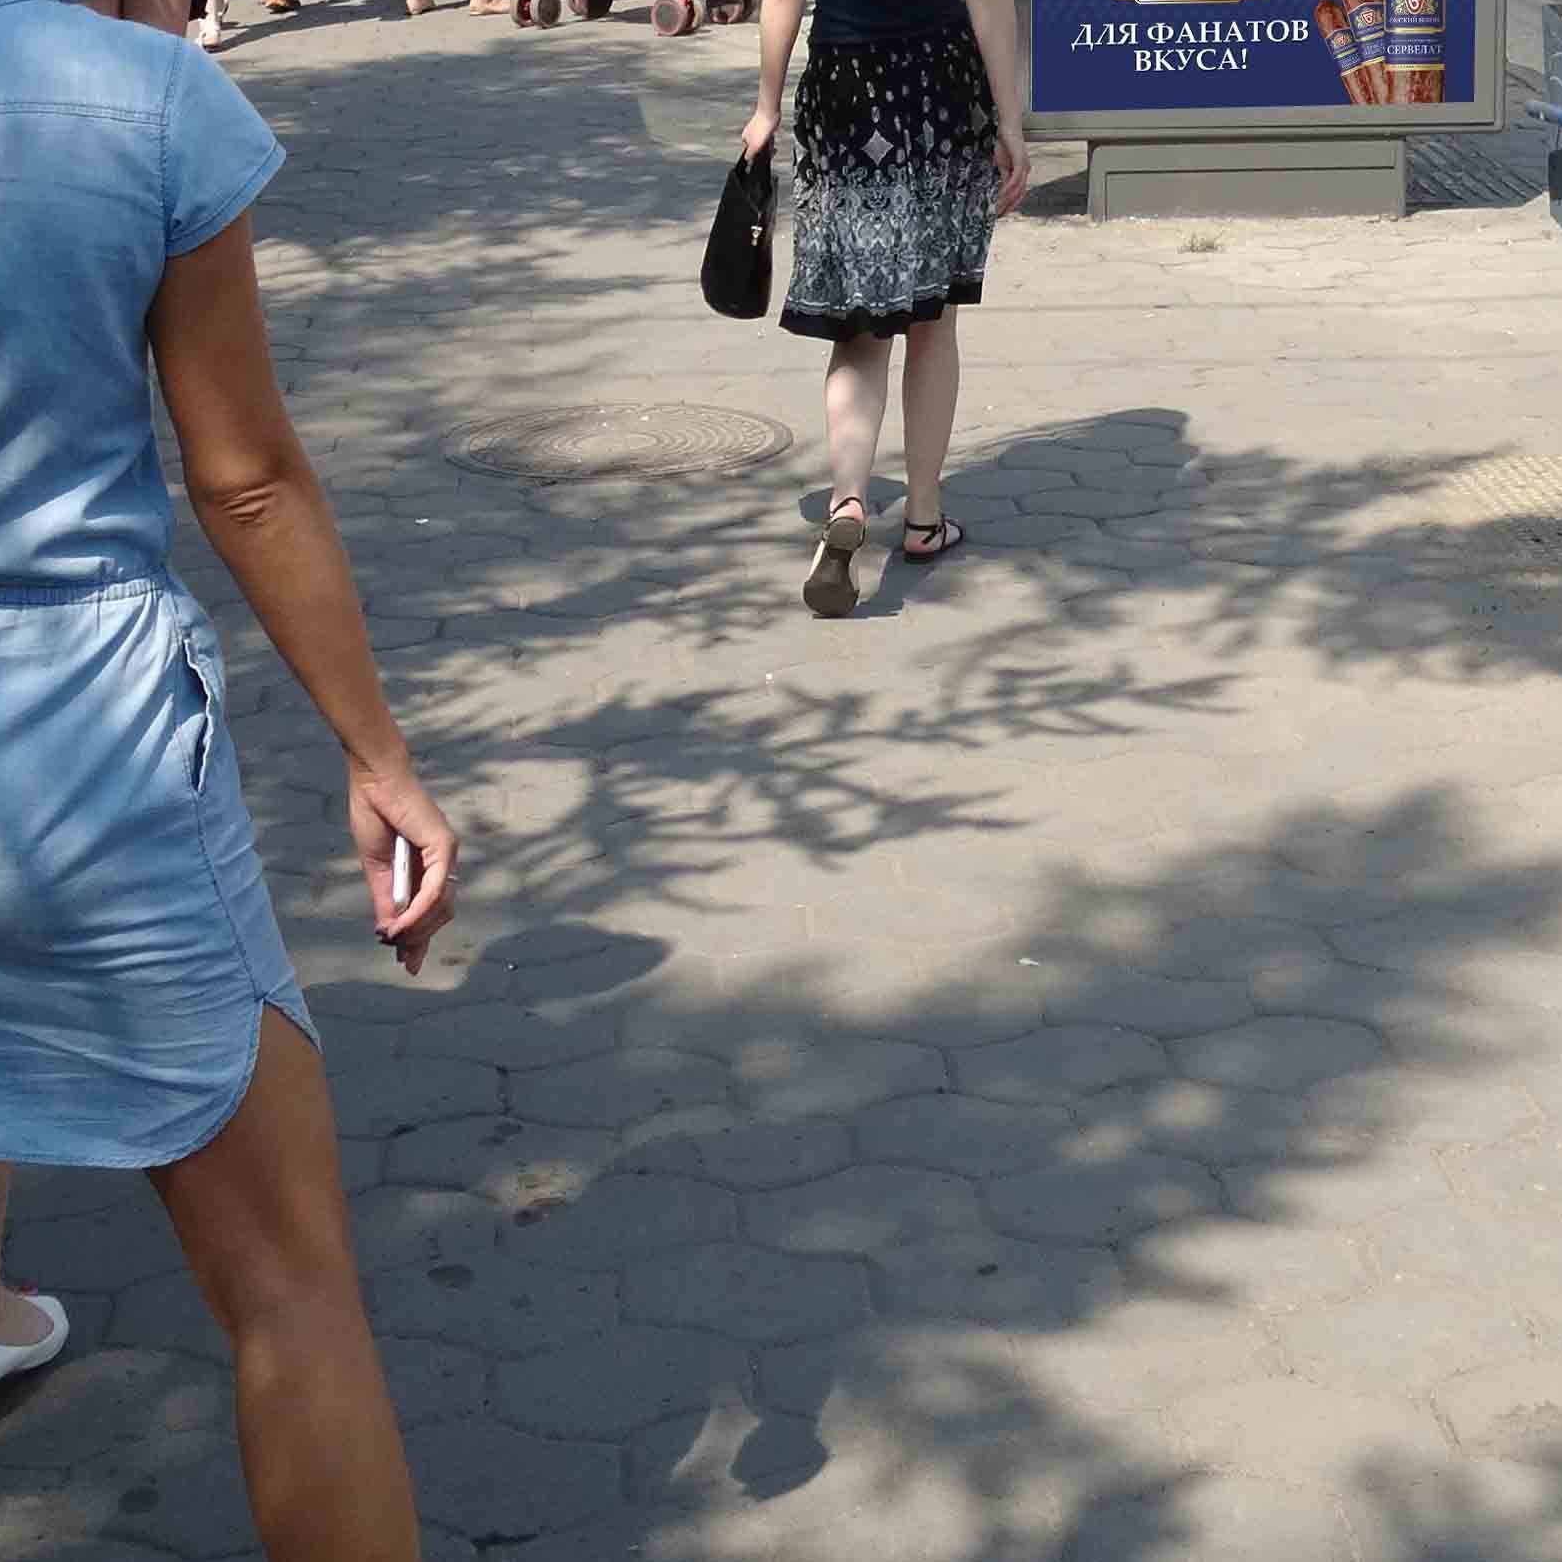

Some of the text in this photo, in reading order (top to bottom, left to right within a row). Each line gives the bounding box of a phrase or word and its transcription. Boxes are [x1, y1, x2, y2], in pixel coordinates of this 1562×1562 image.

[1071, 19, 1310, 51] ДЛЯ ФАНАТОВ
[1135, 48, 1248, 72] ВКУСА!
[1387, 44, 1445, 55] СЕРВЕЛАТ
